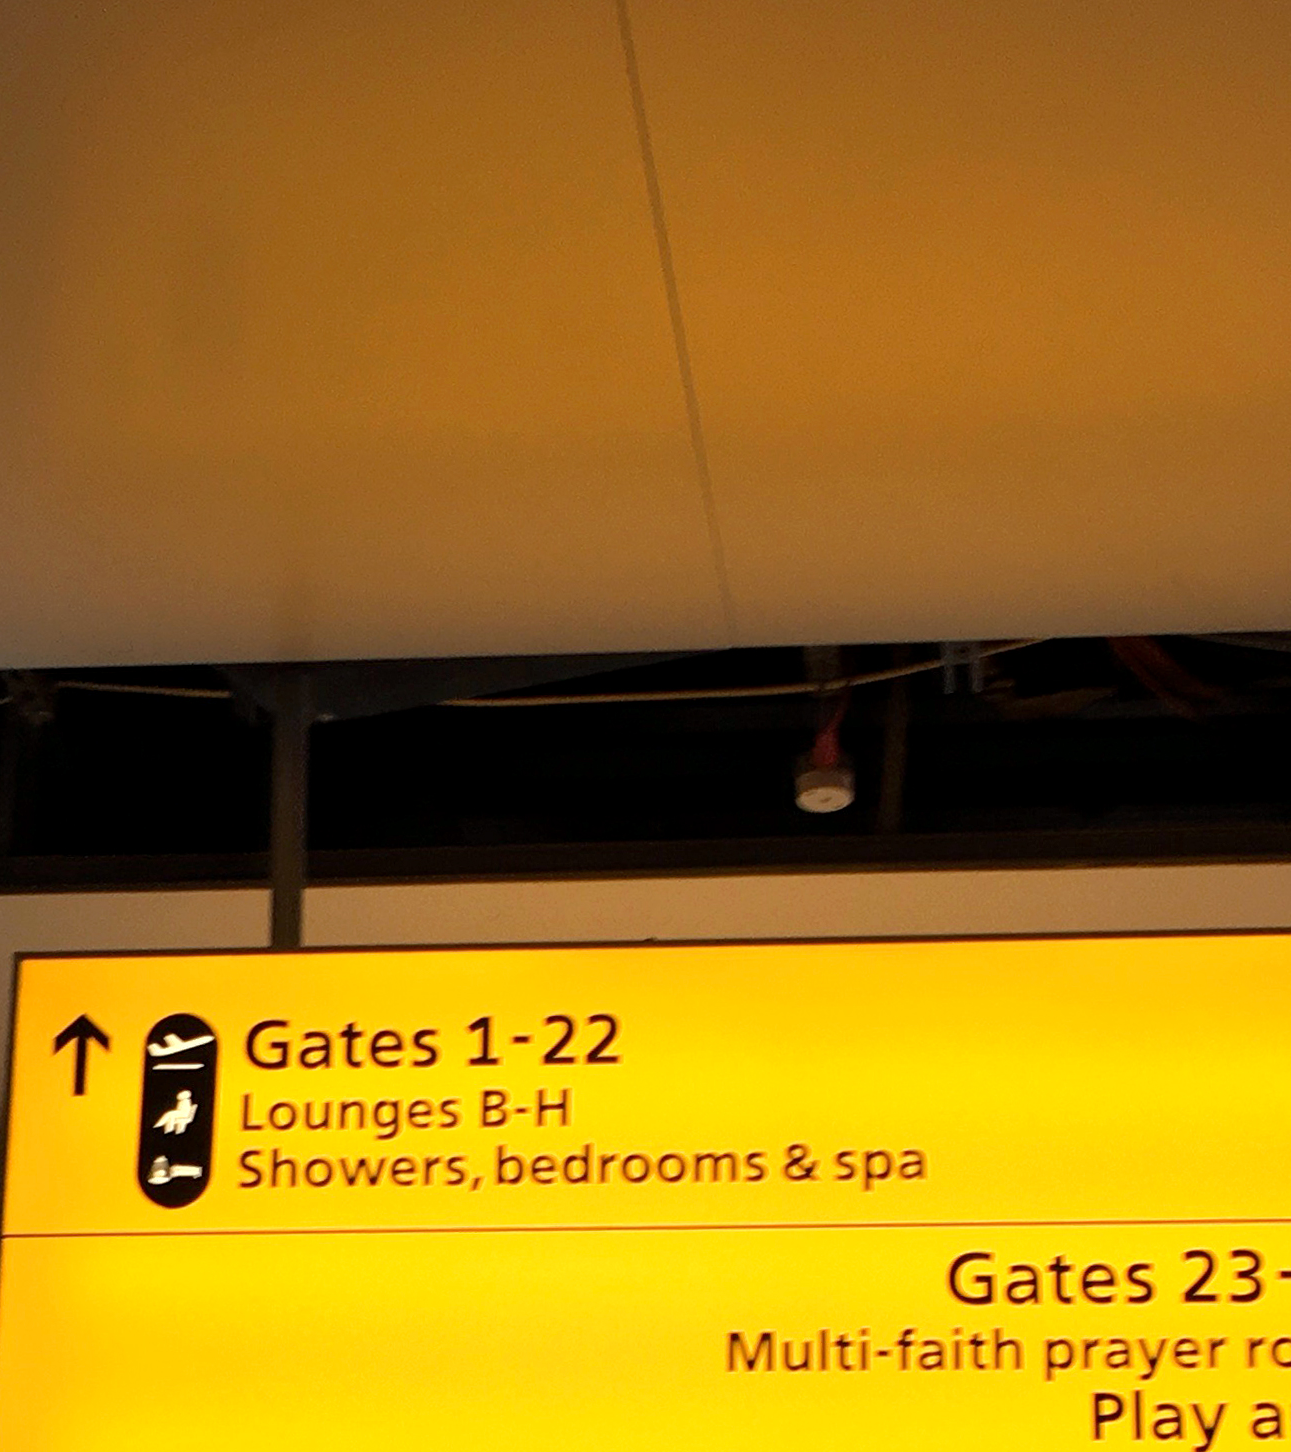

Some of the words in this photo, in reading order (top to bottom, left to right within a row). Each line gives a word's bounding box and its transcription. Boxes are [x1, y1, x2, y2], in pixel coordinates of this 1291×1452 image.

[245, 1019, 439, 1071] Gates
[467, 1013, 621, 1067] 1-22
[242, 1093, 459, 1141] Lounges
[481, 1089, 572, 1128] B-H
[238, 1148, 483, 1191] Showers,
[496, 1144, 765, 1185] bedrooms
[783, 1143, 819, 1182] &
[835, 1149, 926, 1191] spa
[948, 1251, 1154, 1306] Gates
[727, 1328, 1023, 1373] Multi-faith
[1045, 1328, 1227, 1382] prayer
